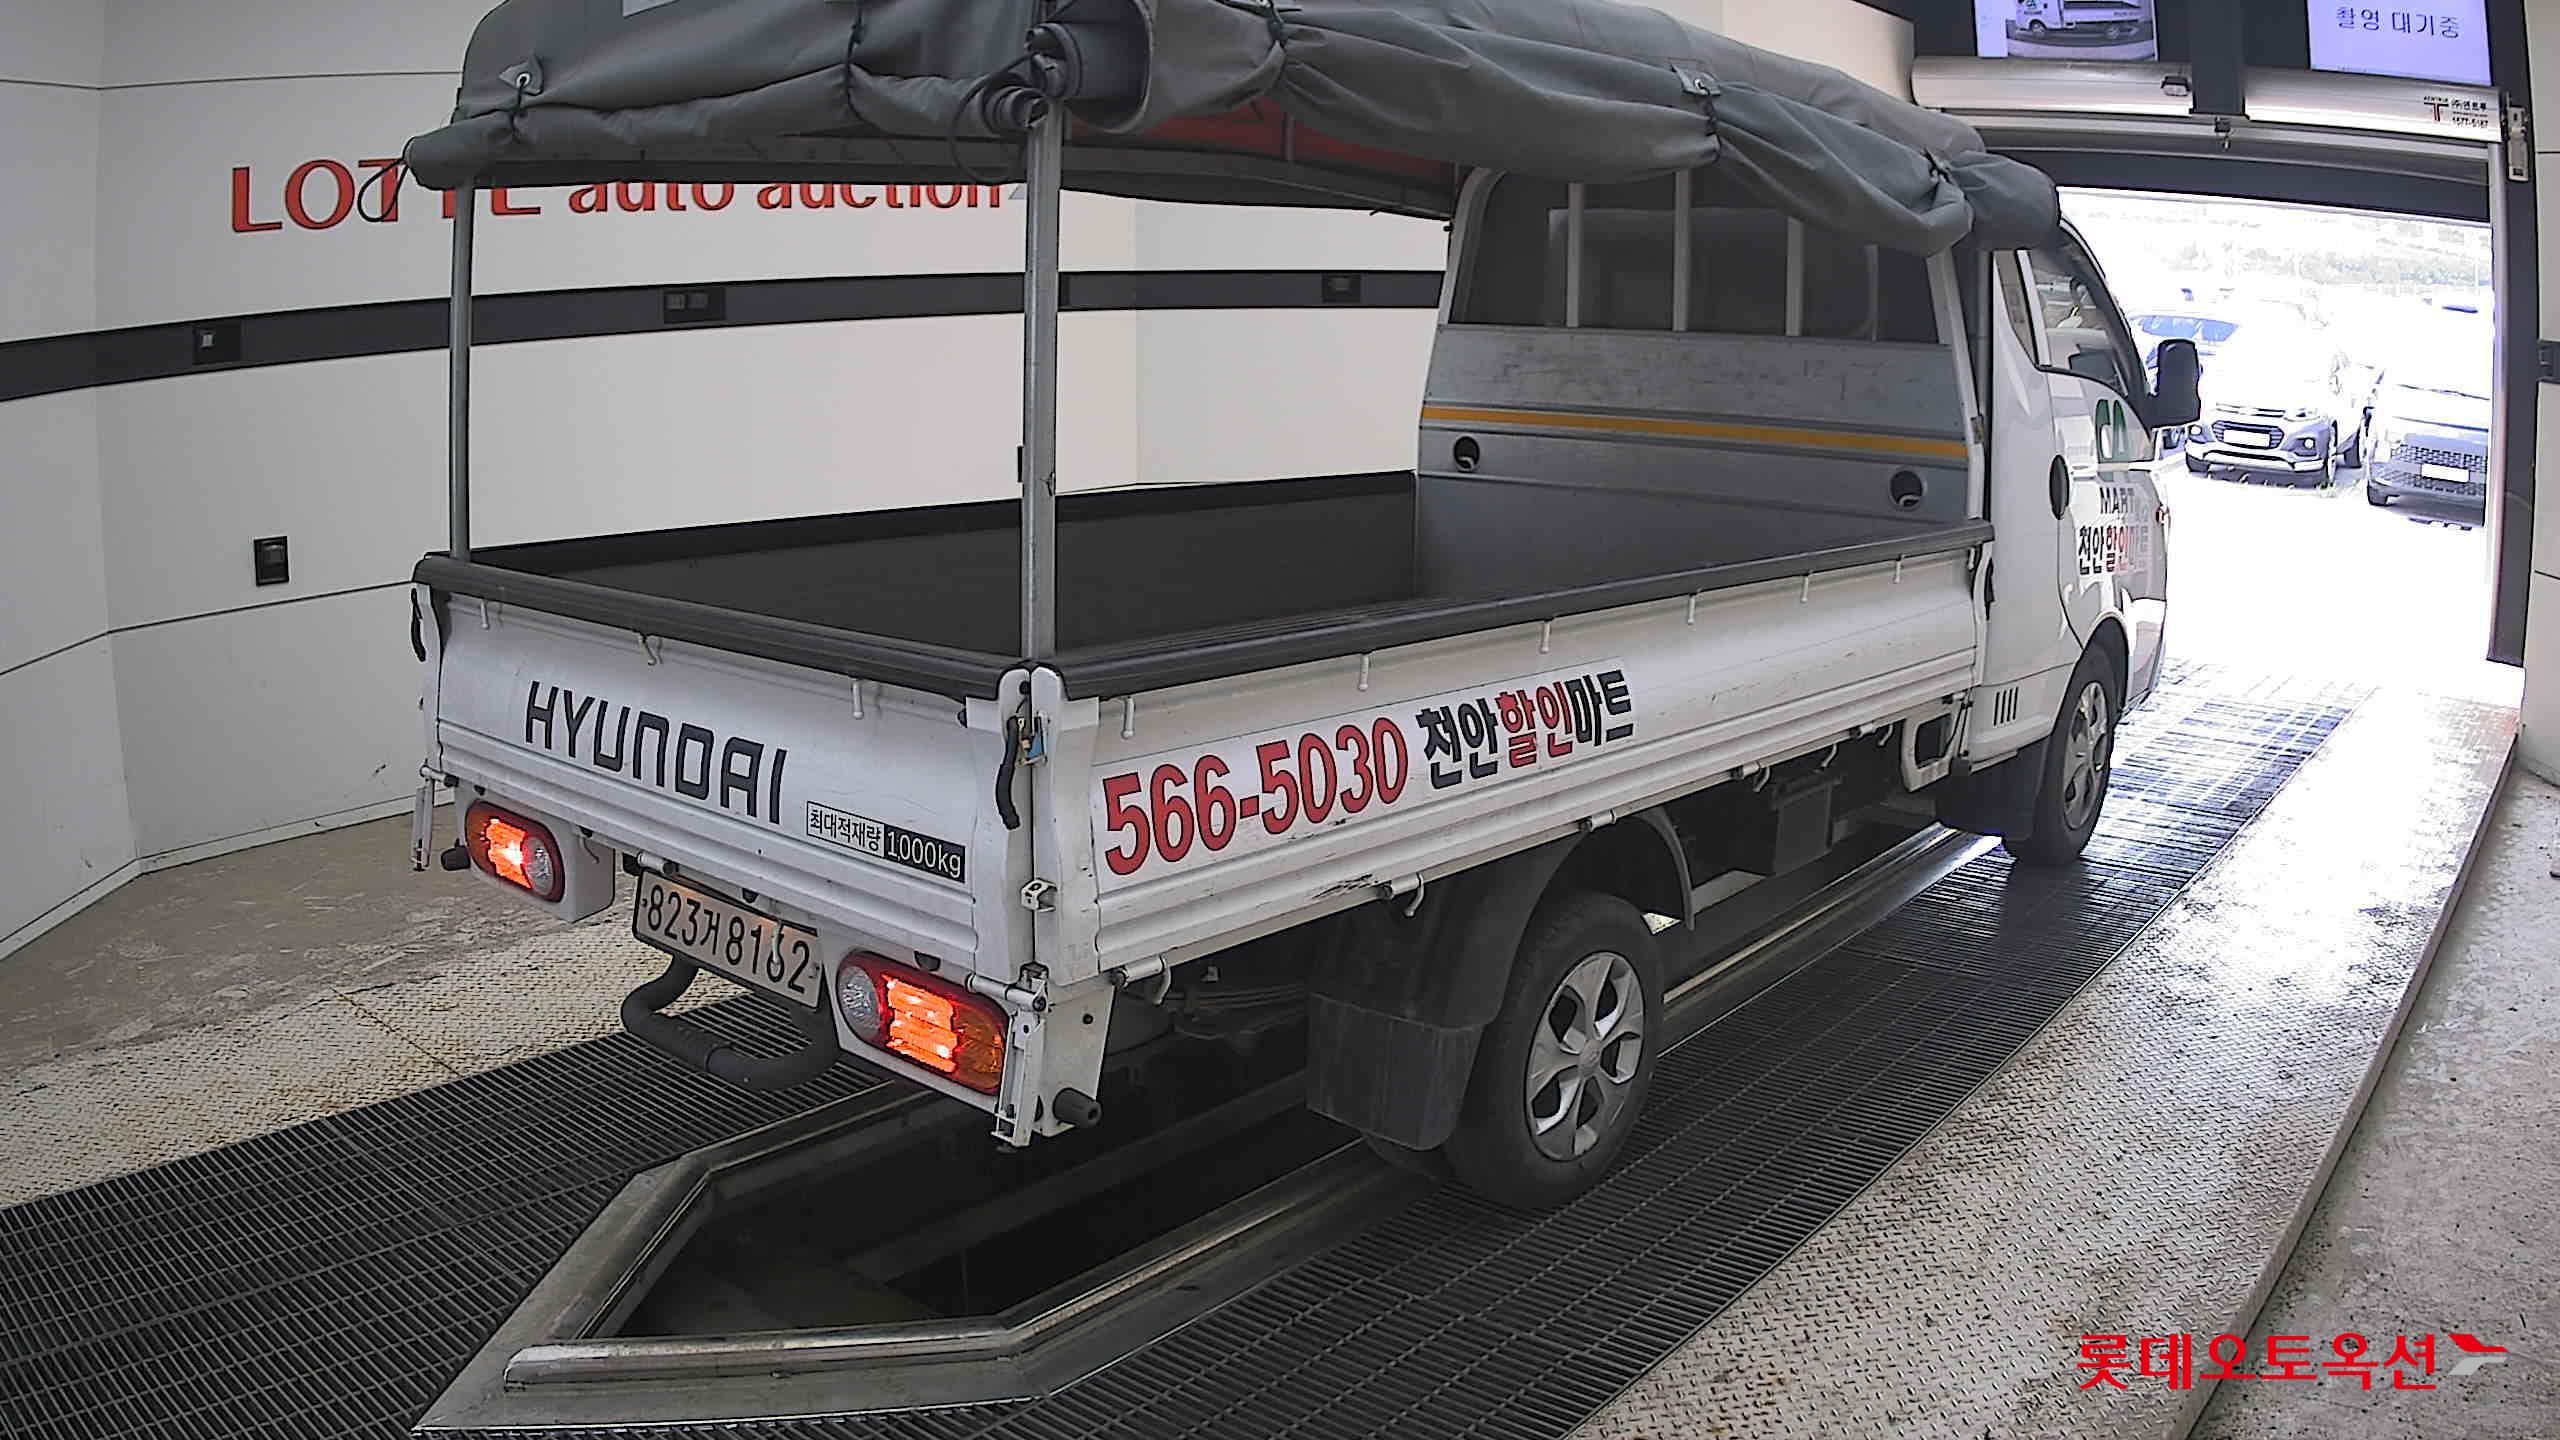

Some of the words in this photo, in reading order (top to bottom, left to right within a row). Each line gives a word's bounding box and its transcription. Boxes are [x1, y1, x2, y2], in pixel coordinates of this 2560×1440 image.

[2337, 6, 2380, 32] 촬영
[2391, 11, 2460, 39] 대기중
[568, 180, 736, 213] auto
[524, 680, 788, 825] HYUNDAI
[1102, 716, 1409, 876] 566-5030
[1415, 668, 1635, 790] 천안할인마트
[809, 808, 882, 852] 최대적재량
